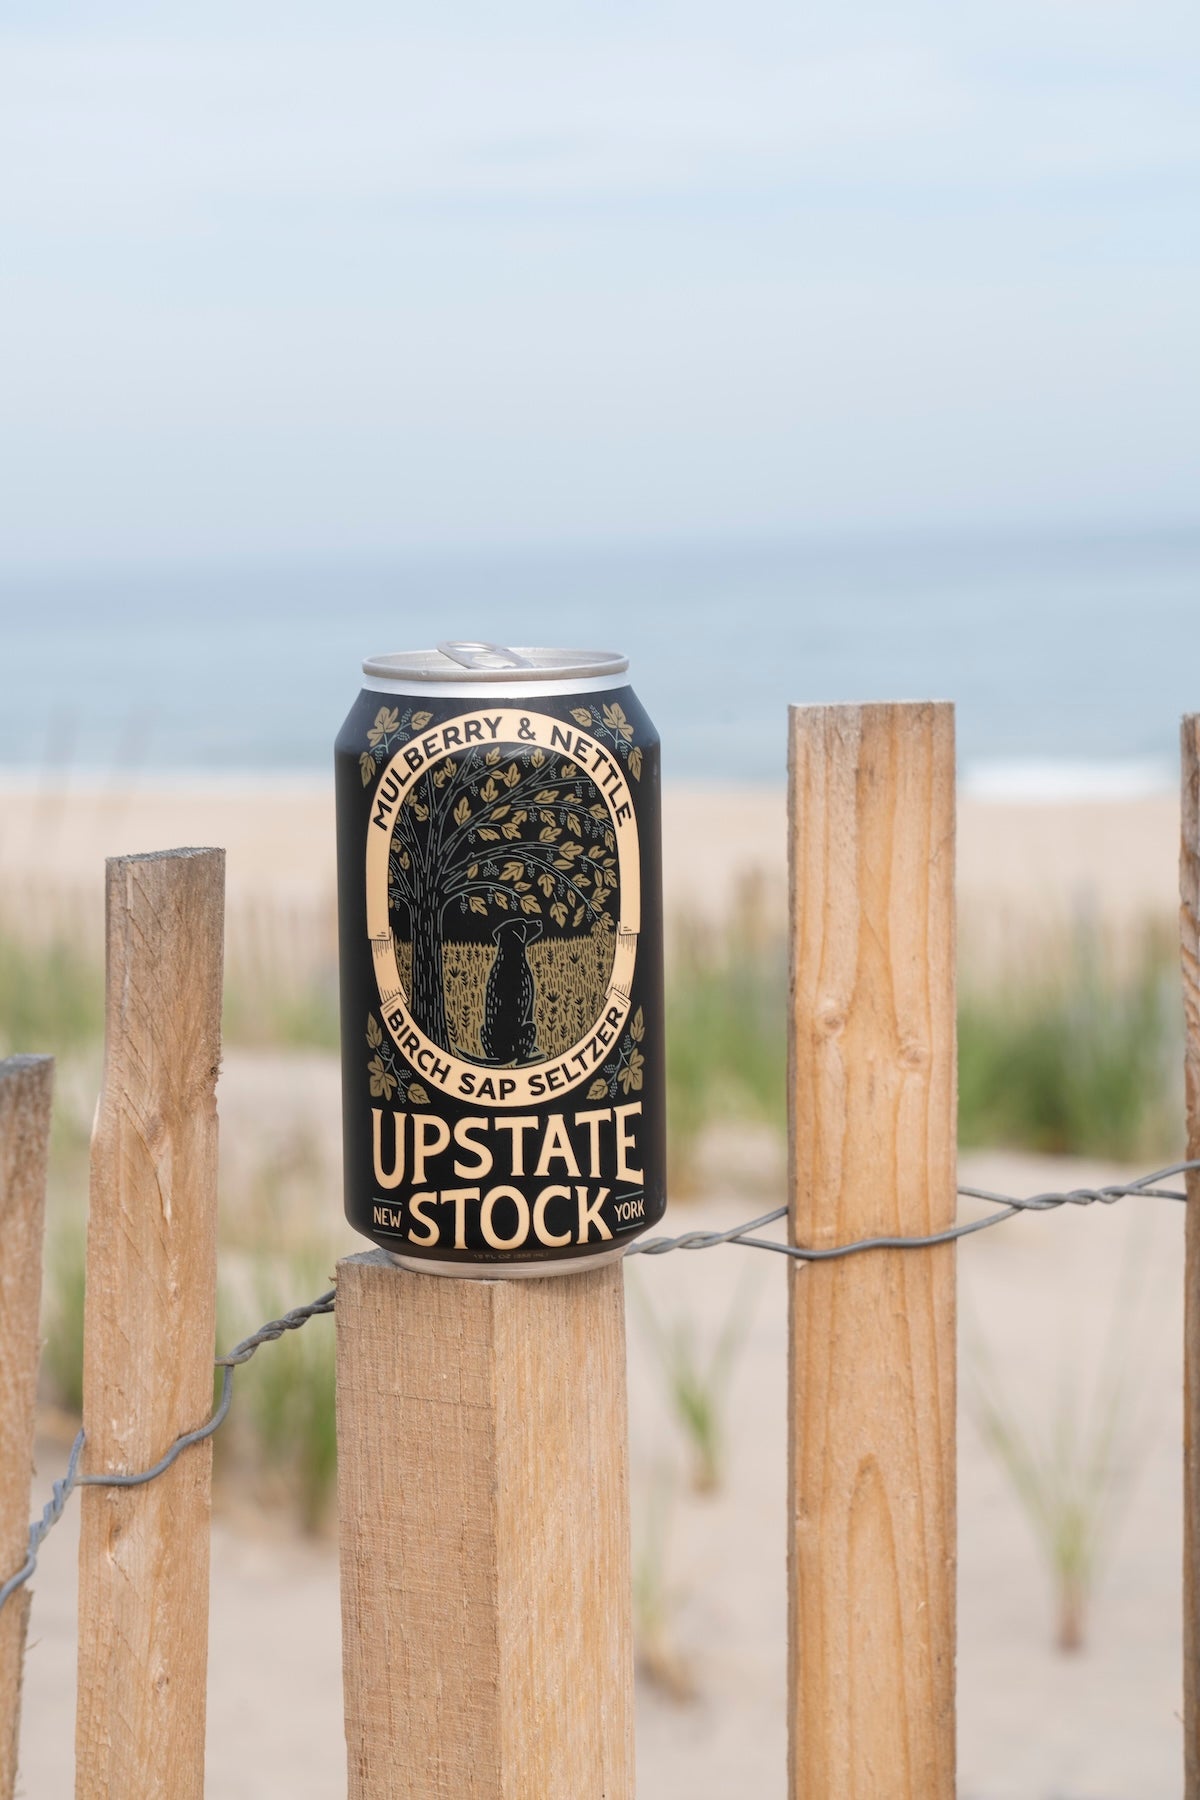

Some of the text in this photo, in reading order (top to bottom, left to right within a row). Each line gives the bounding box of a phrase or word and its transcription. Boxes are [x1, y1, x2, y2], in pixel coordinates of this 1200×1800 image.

[373, 716, 632, 831] MULBERRY & NETTLE
[388, 1005, 624, 1100] BIRCH SAP SELTZER
[371, 1101, 644, 1190] UPSTATE
[373, 1206, 401, 1228] NEW
[407, 1185, 613, 1250] STOCK
[614, 1198, 645, 1221] YORK
